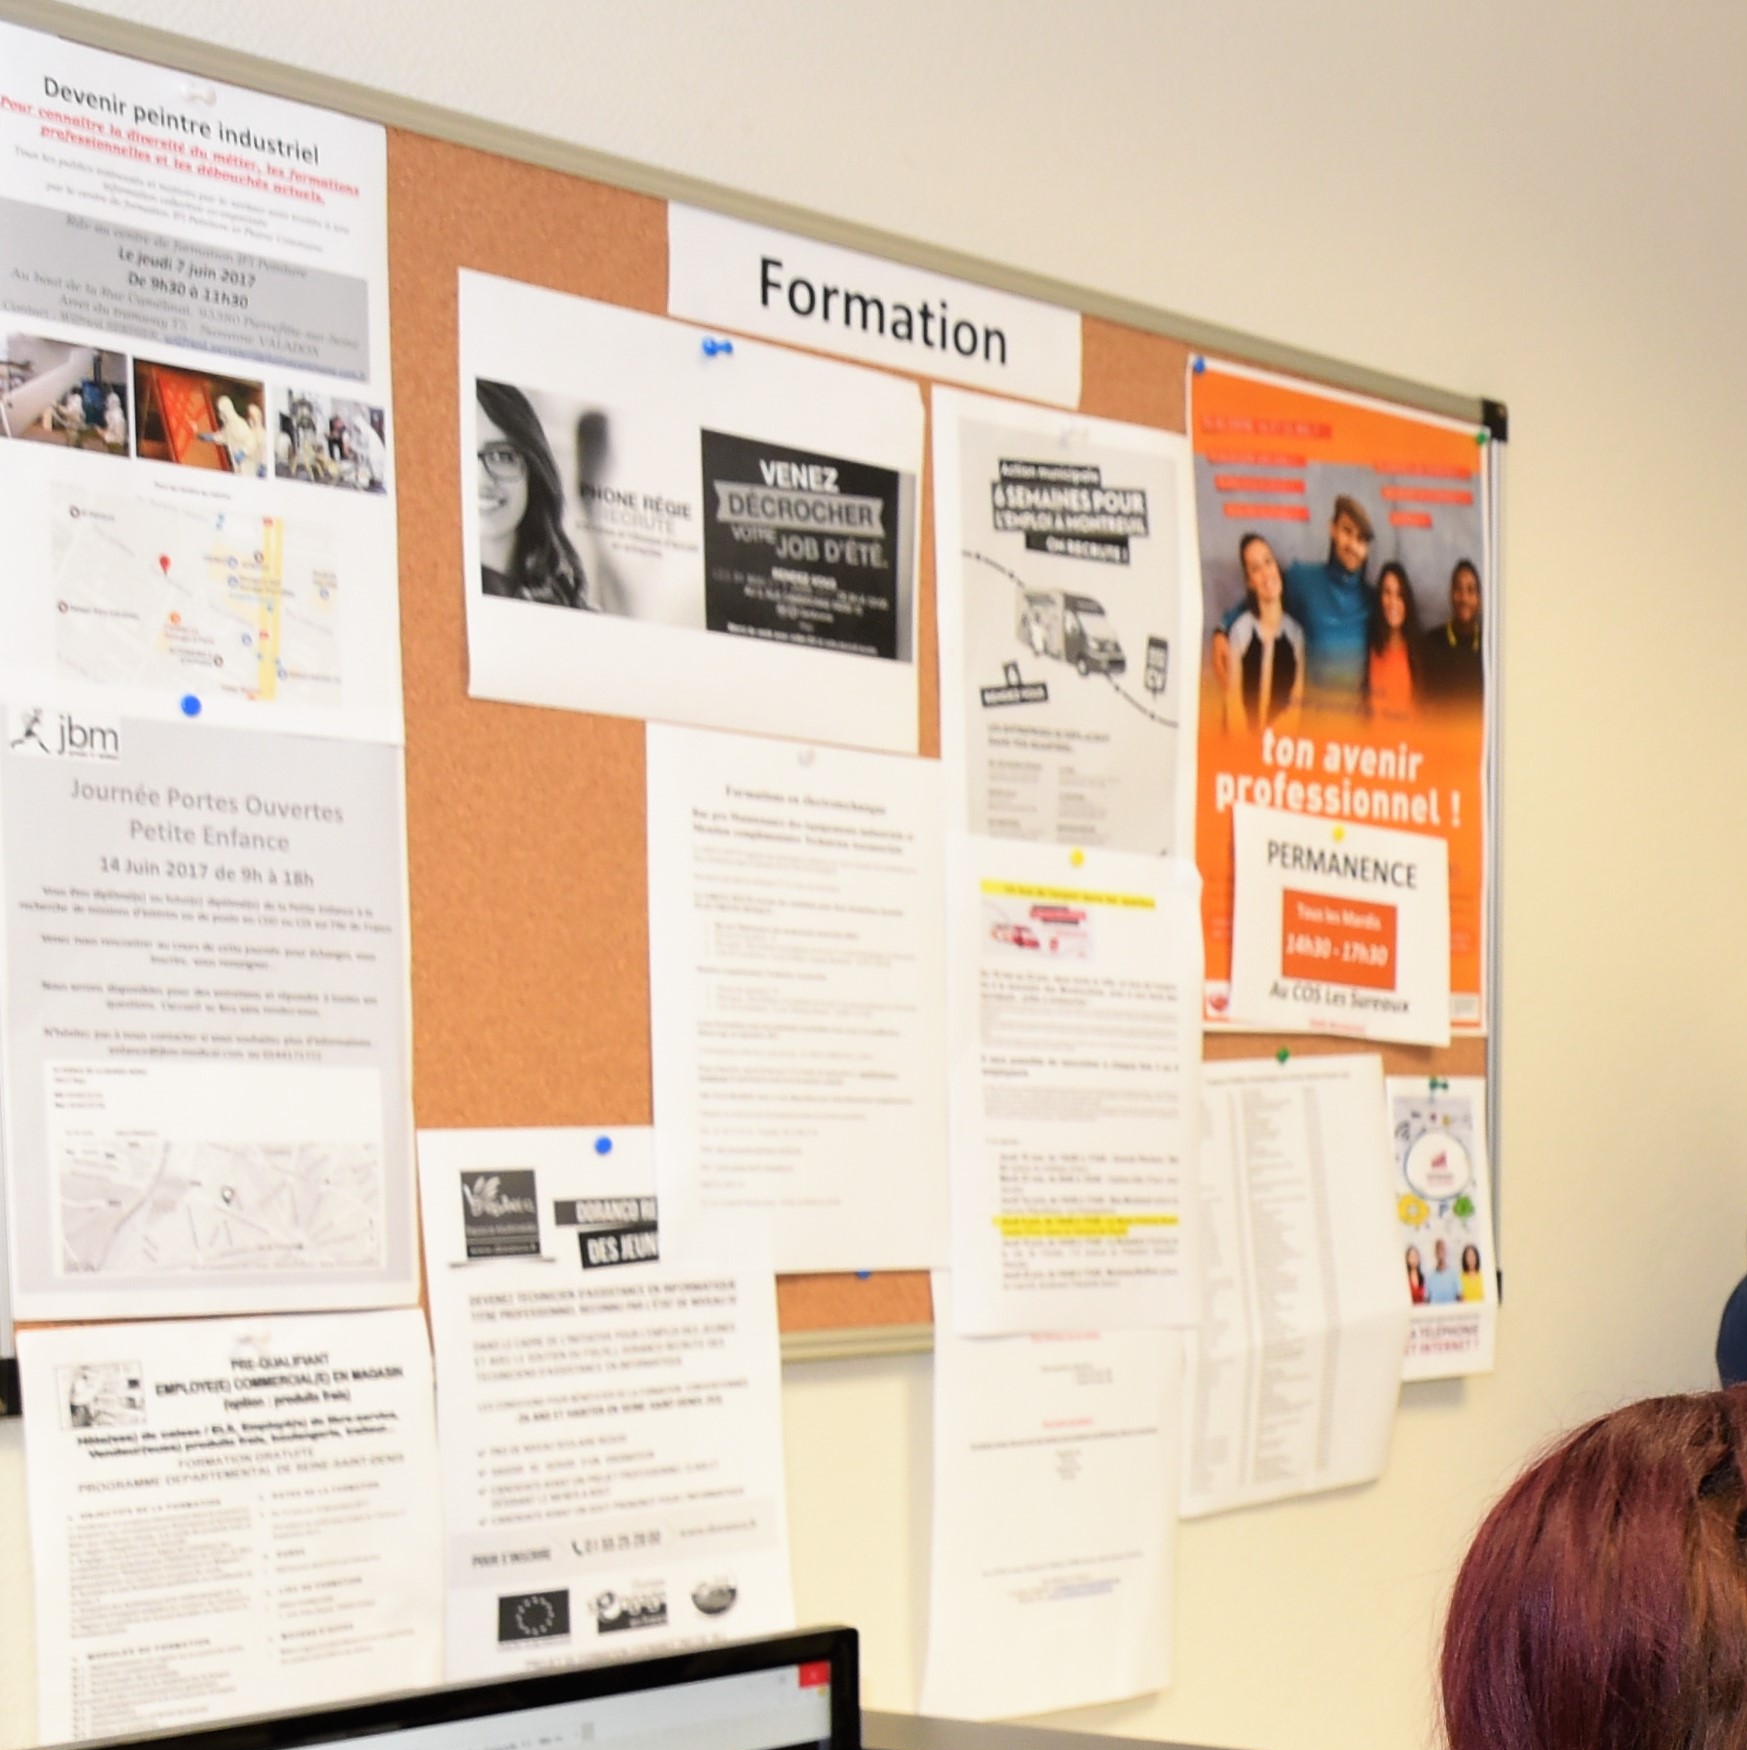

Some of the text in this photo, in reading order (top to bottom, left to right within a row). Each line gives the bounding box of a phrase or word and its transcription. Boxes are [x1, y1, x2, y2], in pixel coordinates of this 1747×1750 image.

[44, 76, 320, 165] Devenir peintre industriel
[0, 95, 33, 116] Pour
[38, 105, 104, 132] connaître
[109, 122, 122, 138] la
[127, 126, 185, 155] diversité
[191, 144, 208, 160] du
[266, 161, 284, 178] les
[288, 164, 360, 197] formations
[41, 124, 151, 163] professionnelles
[156, 154, 169, 168] et
[173, 156, 193, 172] les
[198, 161, 269, 191] débouchés
[118, 246, 257, 289] Le jeudi 7 juin 2017
[128, 269, 249, 309] De 9h30 à 11h30
[759, 256, 1008, 366] Formation
[759, 458, 840, 493] VENEZ
[643, 495, 692, 520] RÉGIE
[728, 494, 874, 527] DÉCROCHER
[1006, 485, 1091, 513] SEMAINES
[1092, 489, 1146, 514] POUR
[732, 525, 776, 545] VOTRE
[775, 534, 819, 561] JOB
[56, 714, 120, 756] jbm
[1262, 727, 1423, 783] ton avenir
[71, 778, 345, 824] Journée Portes Ouvertes
[1215, 770, 1461, 828] professionnel !
[130, 819, 290, 853] Petite Enfance
[99, 857, 315, 887] 14 Juin 2017 de 9h à 18h
[1267, 839, 1417, 889] PERMANENCE
[1286, 933, 1332, 959] 14h30
[1341, 940, 1388, 967] 17h30
[1270, 981, 1288, 999] Au
[1325, 990, 1346, 1007] Les
[1350, 992, 1410, 1013] Sureaux
[587, 1236, 619, 1265] DES
[333, 1368, 349, 1386] EN
[351, 1365, 404, 1382] MAGASIN
[78, 1475, 161, 1494] PROGRAMME
